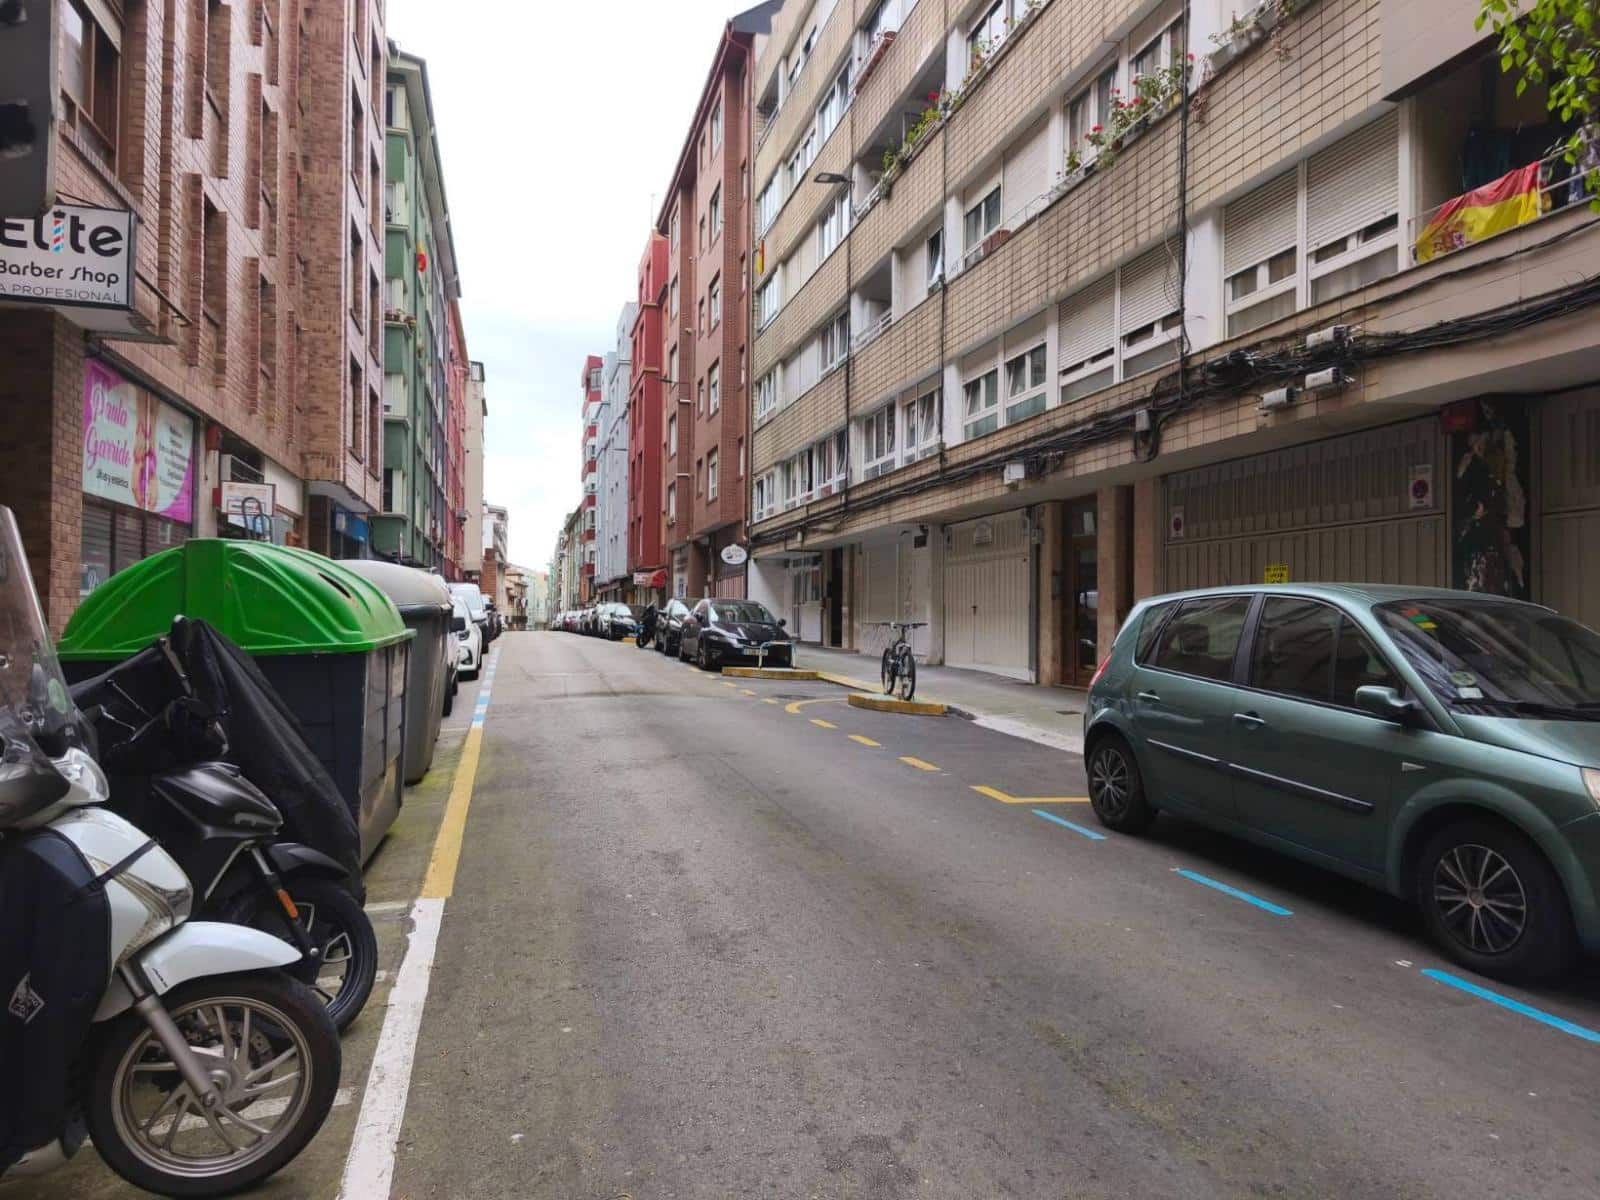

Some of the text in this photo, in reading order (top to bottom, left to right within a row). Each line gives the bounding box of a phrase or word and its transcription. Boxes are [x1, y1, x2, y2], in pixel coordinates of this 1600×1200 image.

[0, 210, 123, 257] Elite
[0, 260, 120, 288] Barber Shop
[12, 284, 120, 303] PROFESIONAL
[91, 383, 128, 428] Paula
